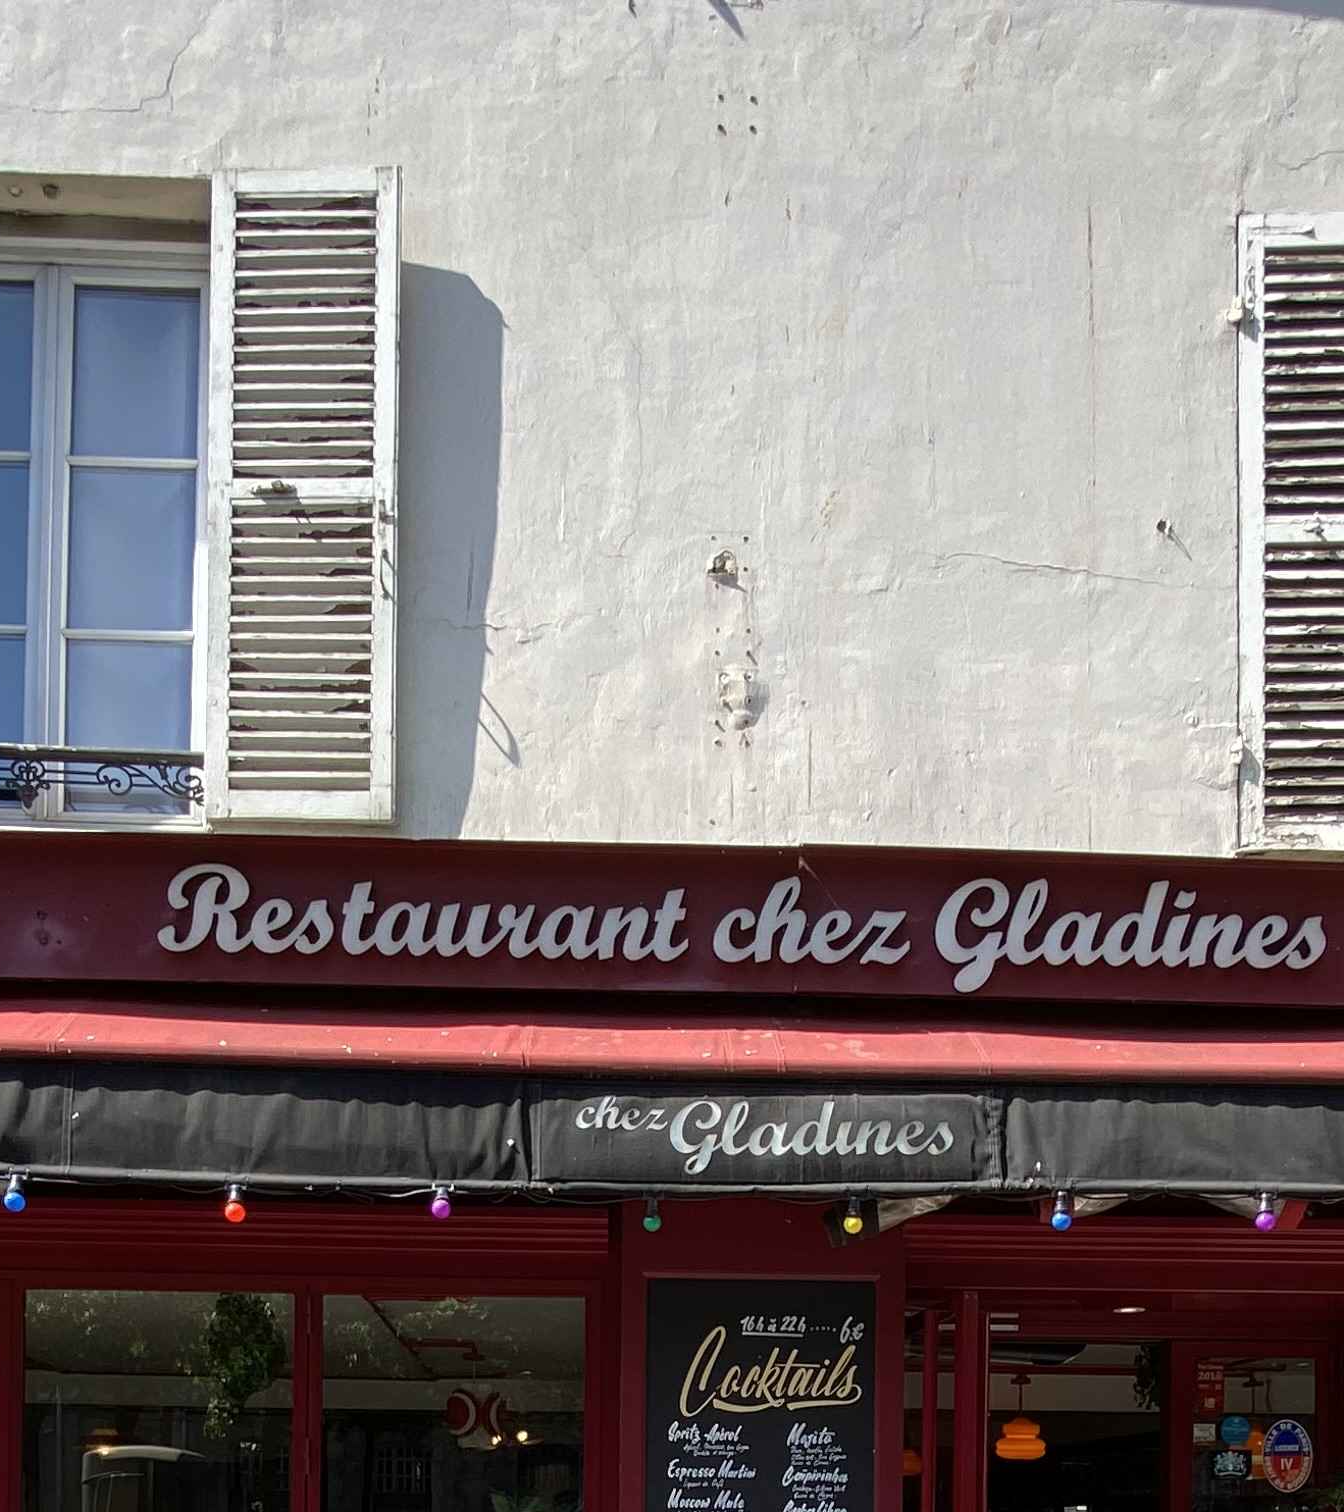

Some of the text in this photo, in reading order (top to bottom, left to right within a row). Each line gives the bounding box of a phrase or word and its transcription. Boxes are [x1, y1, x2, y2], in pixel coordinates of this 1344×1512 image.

[157, 863, 1327, 993] Restaurant chez Gladines
[575, 1096, 954, 1174] chez Gladines
[680, 1326, 862, 1417] Cocktails
[668, 1421, 701, 1444] Spritz
[786, 1422, 836, 1448] Mojito
[667, 1459, 756, 1481] Espresso Martini
[1281, 1458, 1294, 1471] IV
[667, 1488, 745, 1509] Moscow Mule
